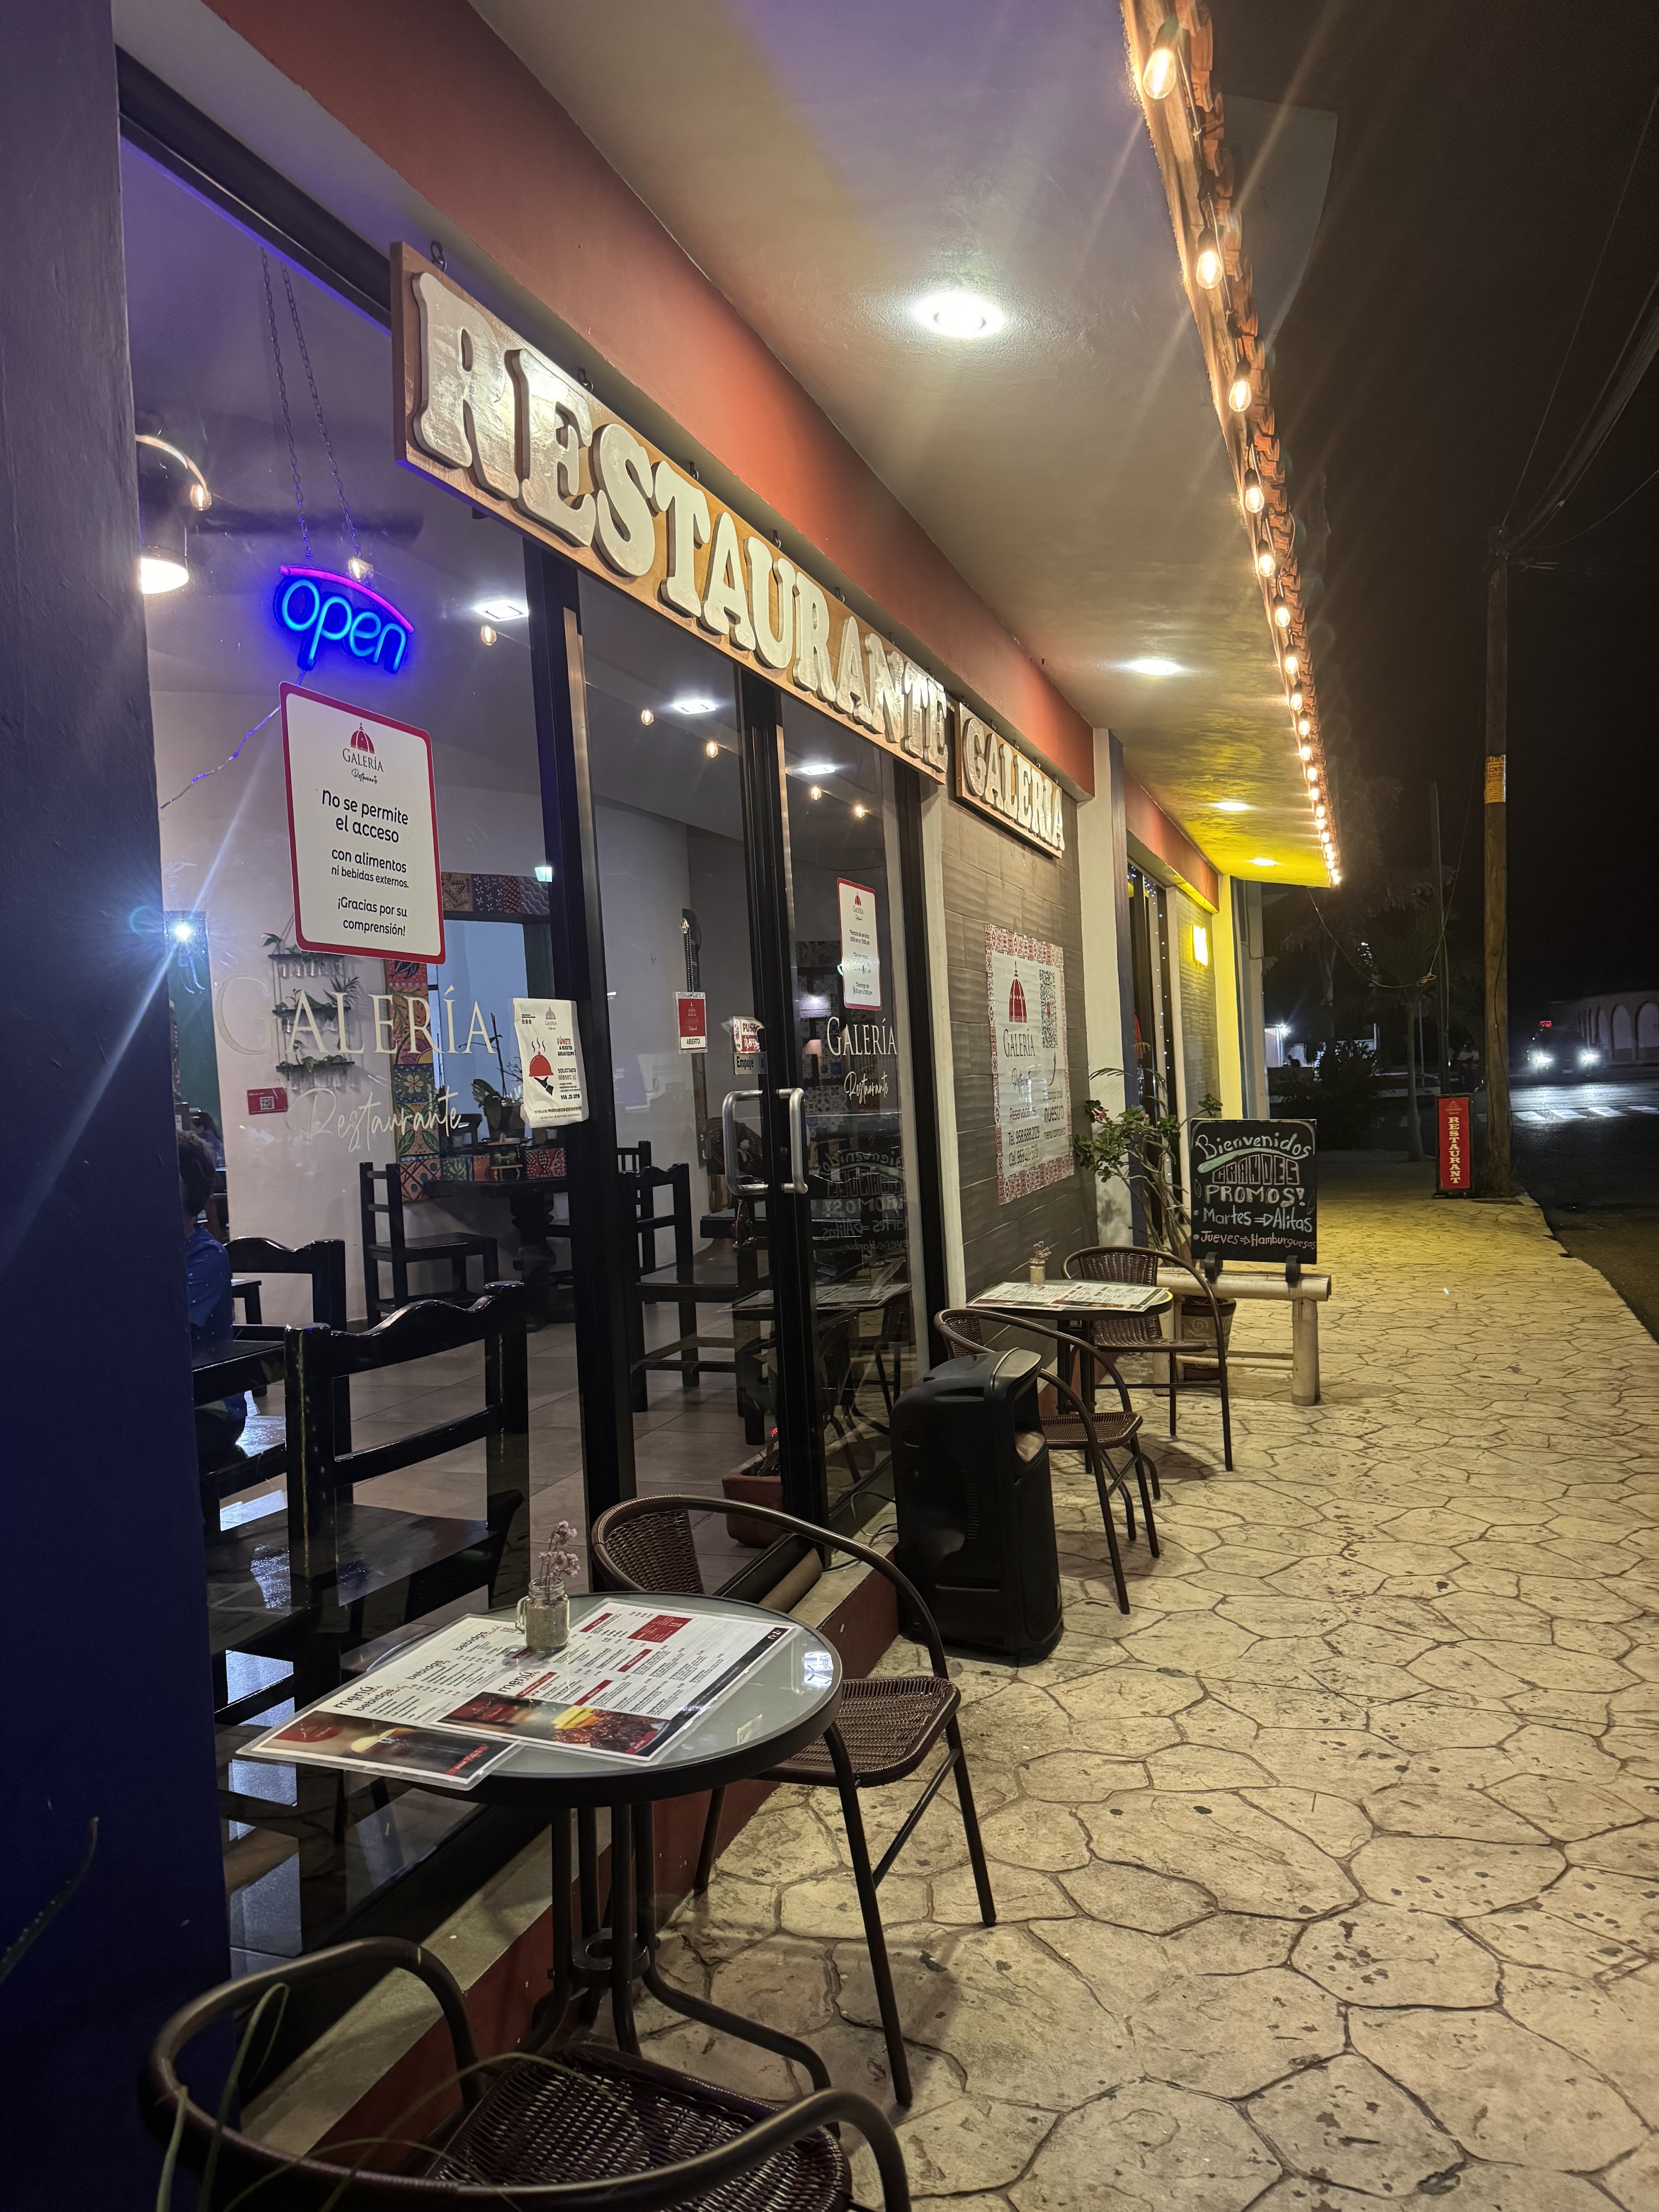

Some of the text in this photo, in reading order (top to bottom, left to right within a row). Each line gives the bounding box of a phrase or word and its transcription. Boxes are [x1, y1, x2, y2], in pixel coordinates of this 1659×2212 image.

[412, 272, 948, 773] RESTAURANTE
[282, 579, 407, 671] open
[342, 748, 384, 772] GALERÍA
[963, 718, 1065, 851] GALERIA
[322, 789, 408, 825] No se permite
[336, 815, 399, 843] el acceso
[332, 849, 407, 873] con alimentos
[331, 865, 409, 888] ni bebidas externos.
[338, 897, 407, 917] ¡Gracias por su
[343, 920, 406, 936] comprensión!
[215, 974, 497, 1056] GALERÍA
[742, 1023, 760, 1032] PUSH
[827, 1016, 898, 1056] GALERÍA
[1003, 1028, 1035, 1057] GALERÍA
[736, 1056, 754, 1070] Empuje
[844, 1071, 889, 1104] Restaurante
[285, 1086, 461, 1153] Restaurante
[1044, 1105, 1064, 1123] nuestro
[1194, 1132, 1312, 1160] Bienvenidos
[1448, 1117, 1461, 1184] RESTAURANT
[1204, 1184, 1306, 1208] PROMOS!
[1203, 1205, 1312, 1233] Martes Alitas
[1200, 1230, 1317, 1250] Jueves Hamburguesas
[452, 1631, 488, 1651] bebidas
[405, 1660, 443, 1680] bebidas
[497, 1671, 532, 1692] menú
[333, 1686, 374, 1708] menú
[352, 1689, 394, 1711] bebidas
